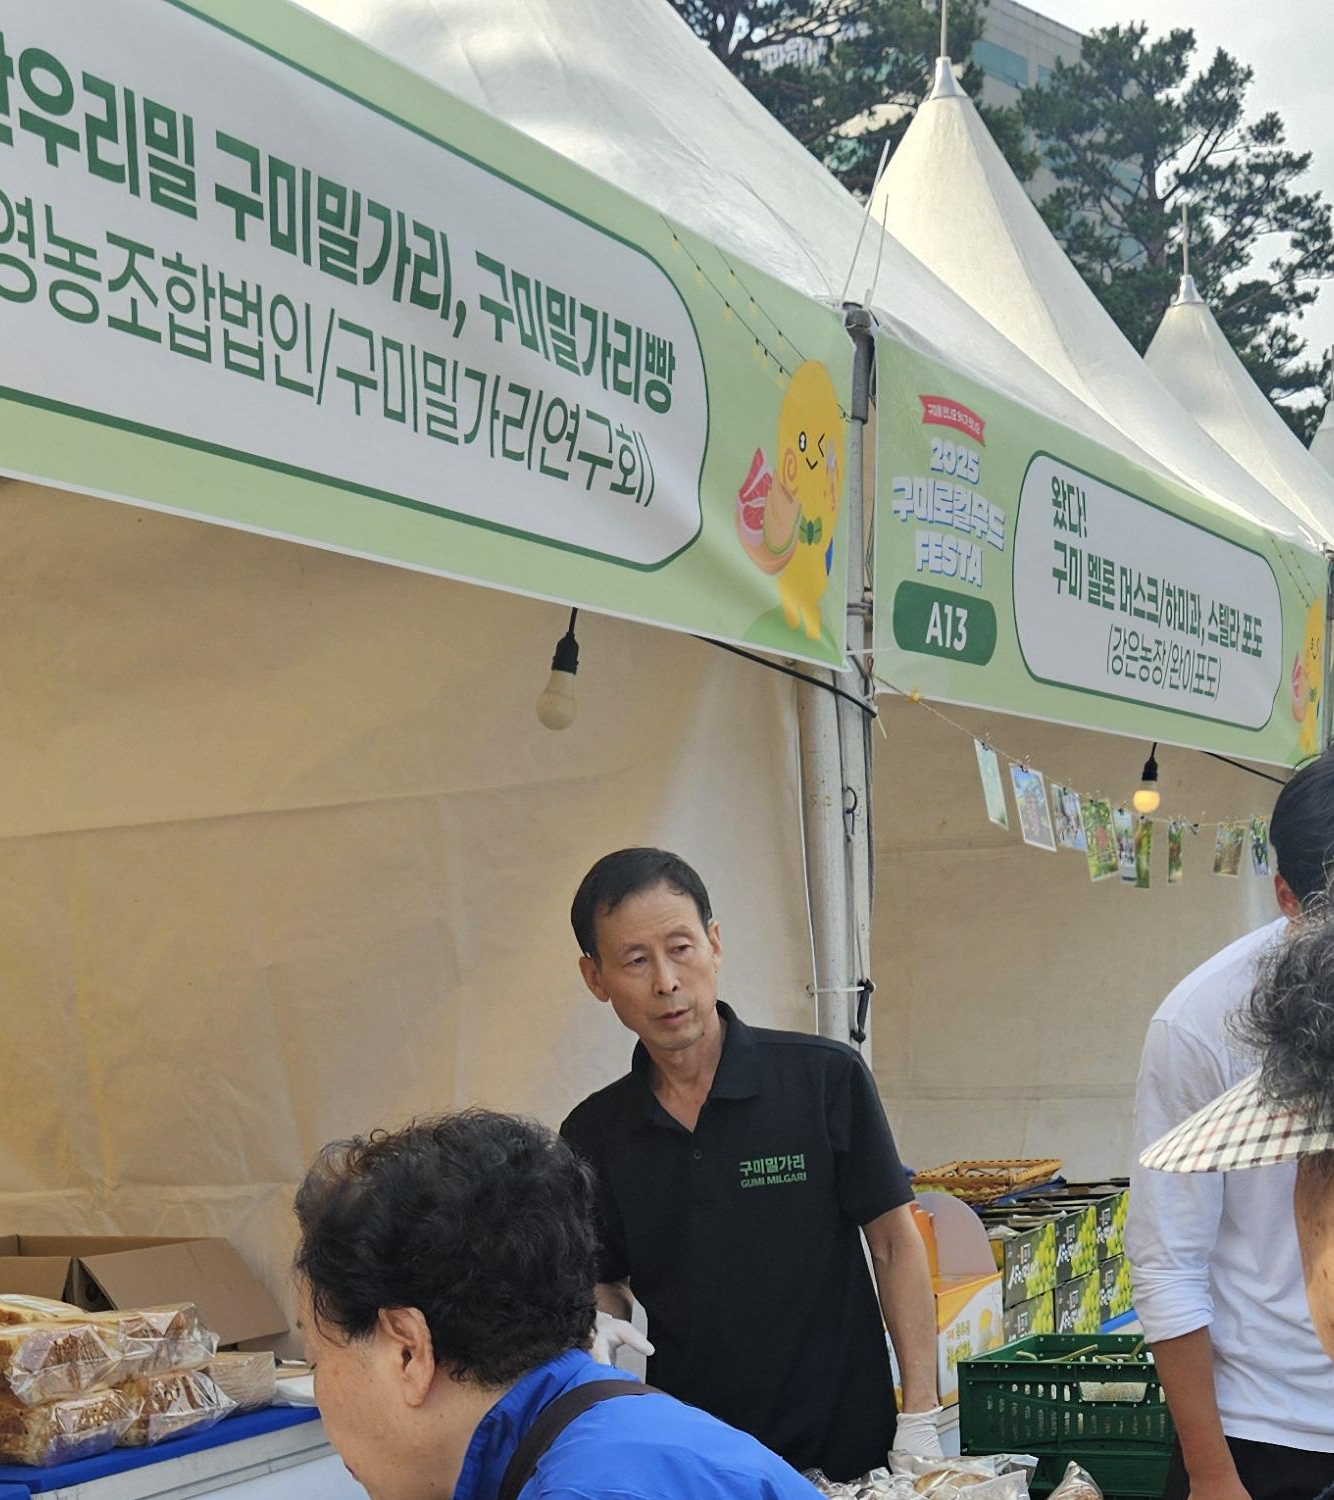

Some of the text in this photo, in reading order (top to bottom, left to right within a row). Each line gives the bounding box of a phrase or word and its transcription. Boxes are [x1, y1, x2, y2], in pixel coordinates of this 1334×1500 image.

[215, 129, 467, 339] 구미밀가리,
[475, 250, 676, 414] 구미밀가리빵
[930, 437, 980, 485] 2025
[892, 476, 1007, 552] 구미로컬푸드
[1051, 475, 1088, 539] 왔다!
[915, 529, 984, 587] FESTA
[925, 602, 969, 652] A13
[1052, 539, 1083, 600] 구미
[1241, 612, 1264, 658] 포도
[739, 1153, 805, 1177] 구미밀가리
[740, 1171, 807, 1189] GUMI MILGARI
